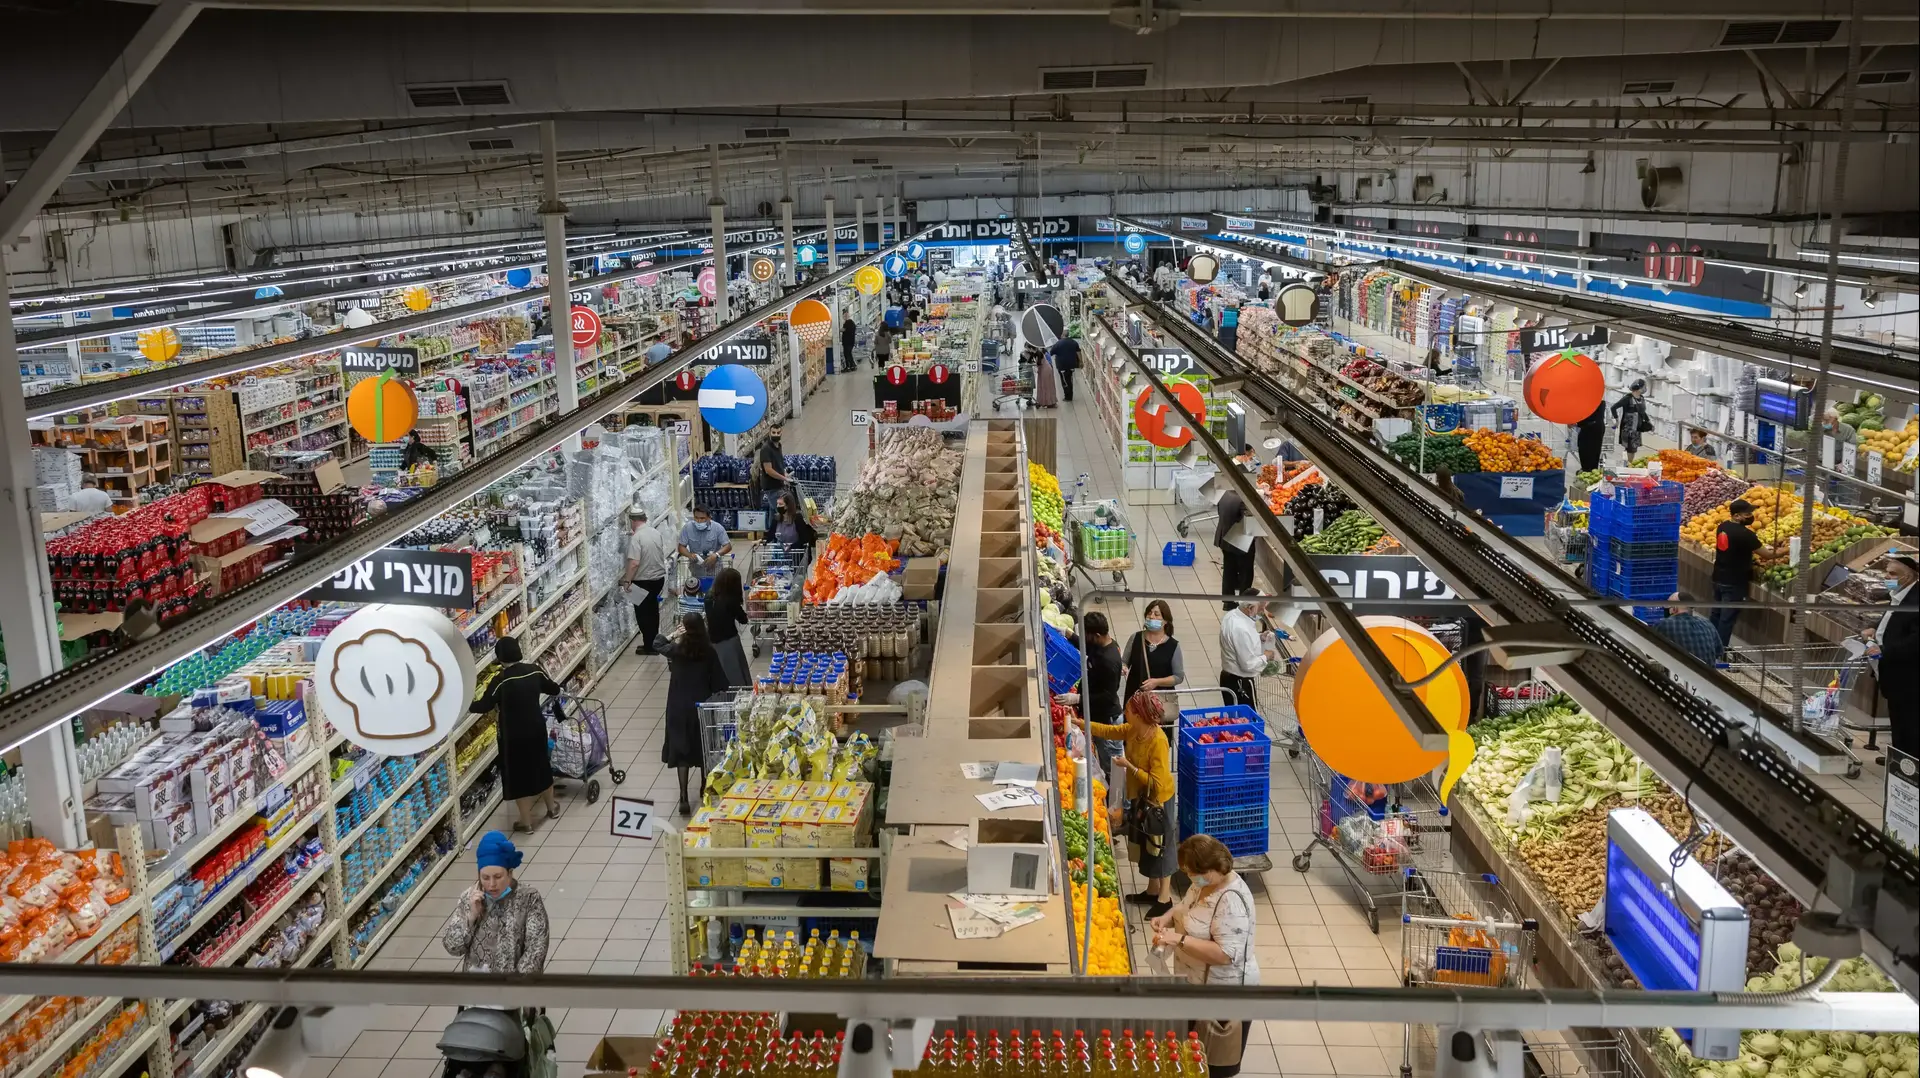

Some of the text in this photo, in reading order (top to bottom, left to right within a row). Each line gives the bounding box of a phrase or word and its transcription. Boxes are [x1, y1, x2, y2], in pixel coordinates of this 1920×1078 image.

[1017, 276, 1061, 290] שיורים
[727, 344, 768, 360] מוצרי
[345, 352, 414, 371] משקאות
[476, 375, 485, 383] 20
[39, 386, 49, 394] 24
[854, 414, 866, 423] 26
[676, 424, 688, 432] 27
[384, 561, 464, 597] מוצרי
[617, 810, 648, 831] 27
[751, 826, 775, 835] Splenda
